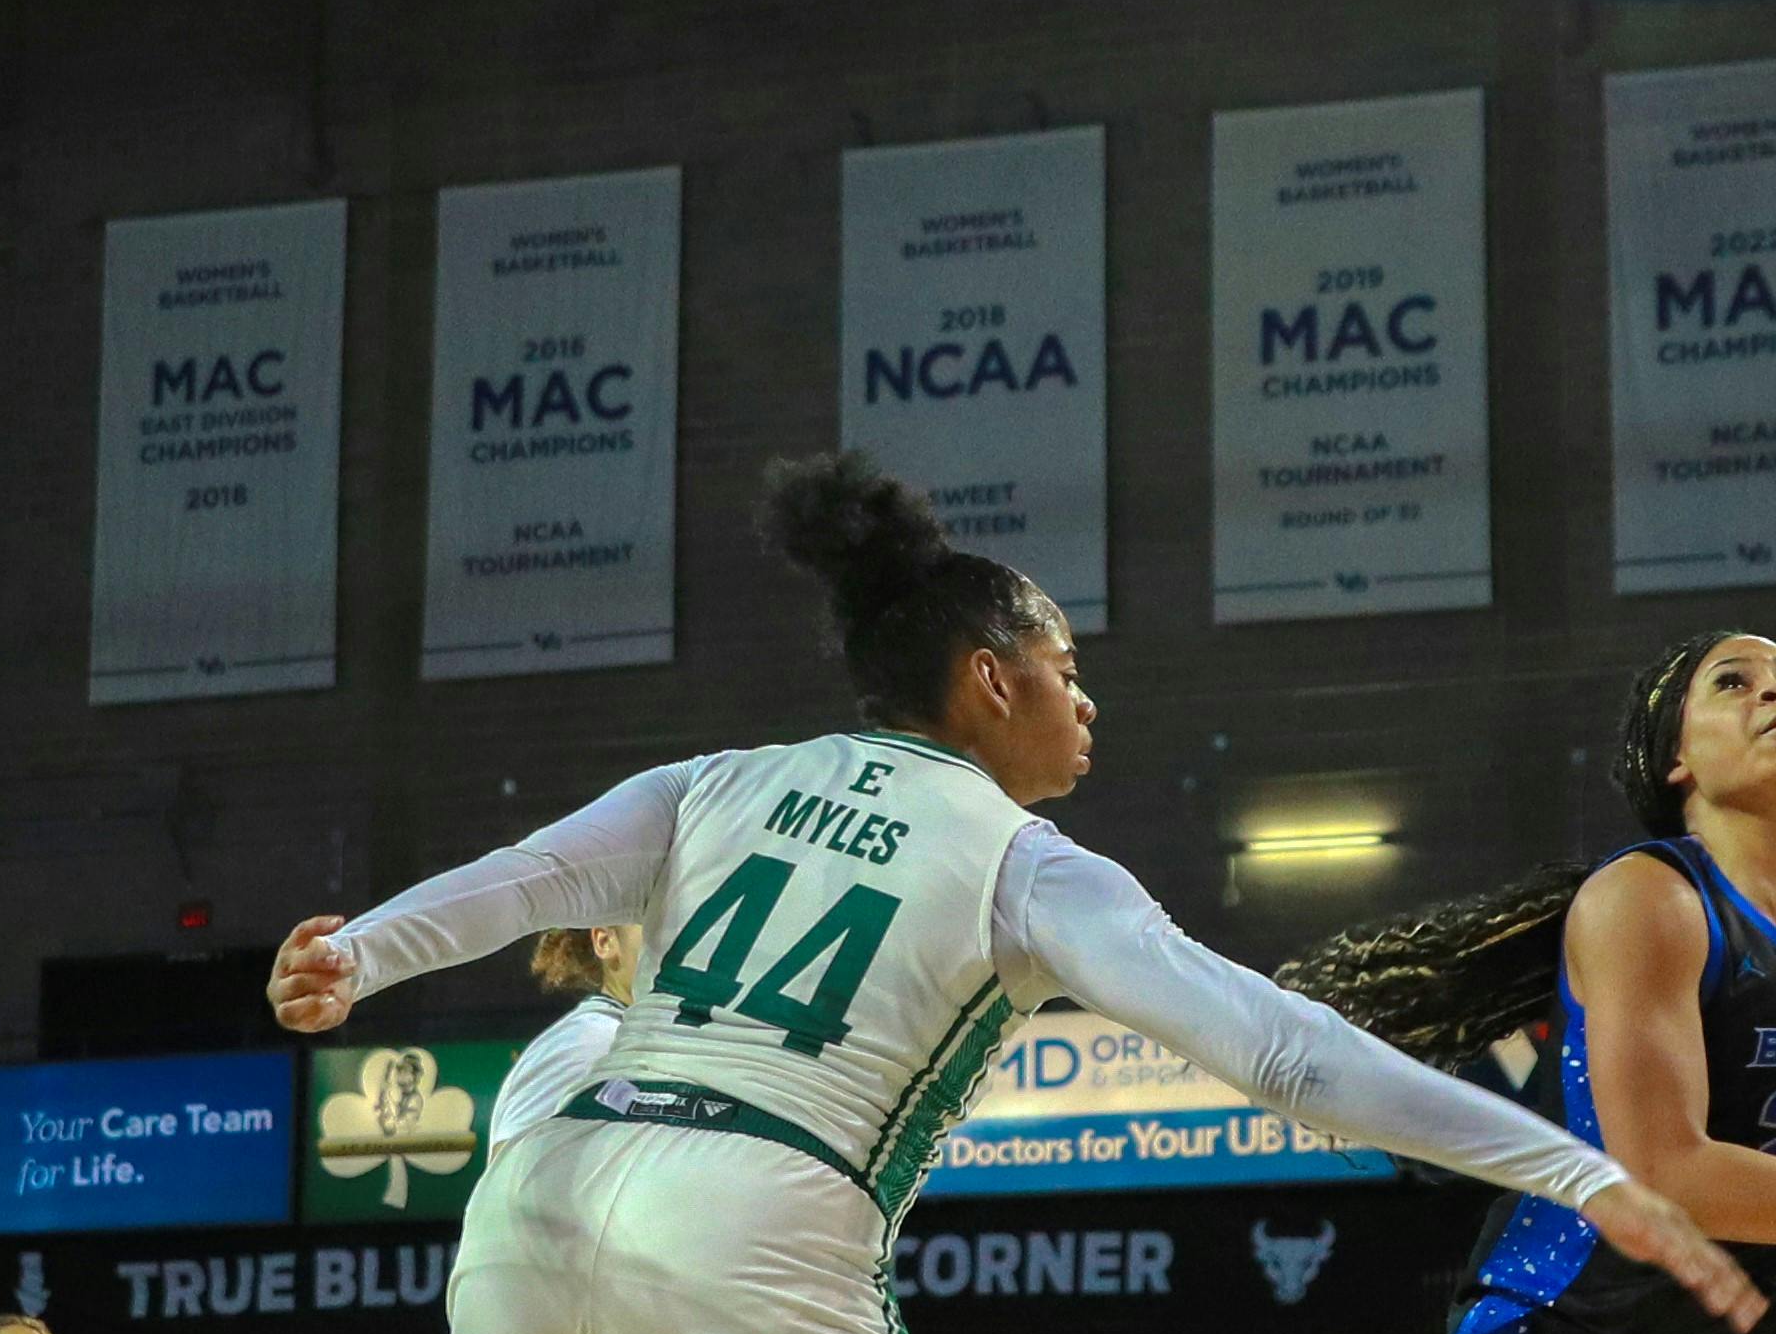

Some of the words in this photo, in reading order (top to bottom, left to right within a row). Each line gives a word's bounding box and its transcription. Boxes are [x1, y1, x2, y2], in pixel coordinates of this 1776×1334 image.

[1258, 294, 1439, 366] MAC
[150, 347, 288, 408] MAC
[864, 333, 1078, 405] NCAA
[1260, 362, 1441, 400] CHAMPIONS
[470, 361, 635, 432] MAC
[140, 413, 195, 437] EAST
[200, 404, 299, 433] DIVISION
[139, 429, 298, 465] CHAMPIONS
[470, 430, 635, 465] CHAMPIONS
[1311, 432, 1391, 458] NCAA
[1258, 454, 1446, 490] TOURNAMENT
[511, 519, 586, 544] NCAA
[462, 542, 635, 577] TOURNAMENT
[849, 761, 895, 797] E
[764, 788, 911, 866] MYLES
[651, 852, 903, 1058] 44
[23, 1108, 93, 1142] Your
[100, 1107, 177, 1139] Care
[186, 1102, 273, 1135] Team
[950, 1127, 1074, 1167] Doctors
[1078, 1128, 1128, 1164] for
[1128, 1118, 1222, 1158] Your
[1227, 1115, 1285, 1154] UB
[16, 1158, 65, 1196] for
[72, 1155, 145, 1188] Life.
[117, 1250, 296, 1318] TRUE
[315, 1242, 460, 1310] BLU
[891, 1228, 1176, 1300] CORNER
